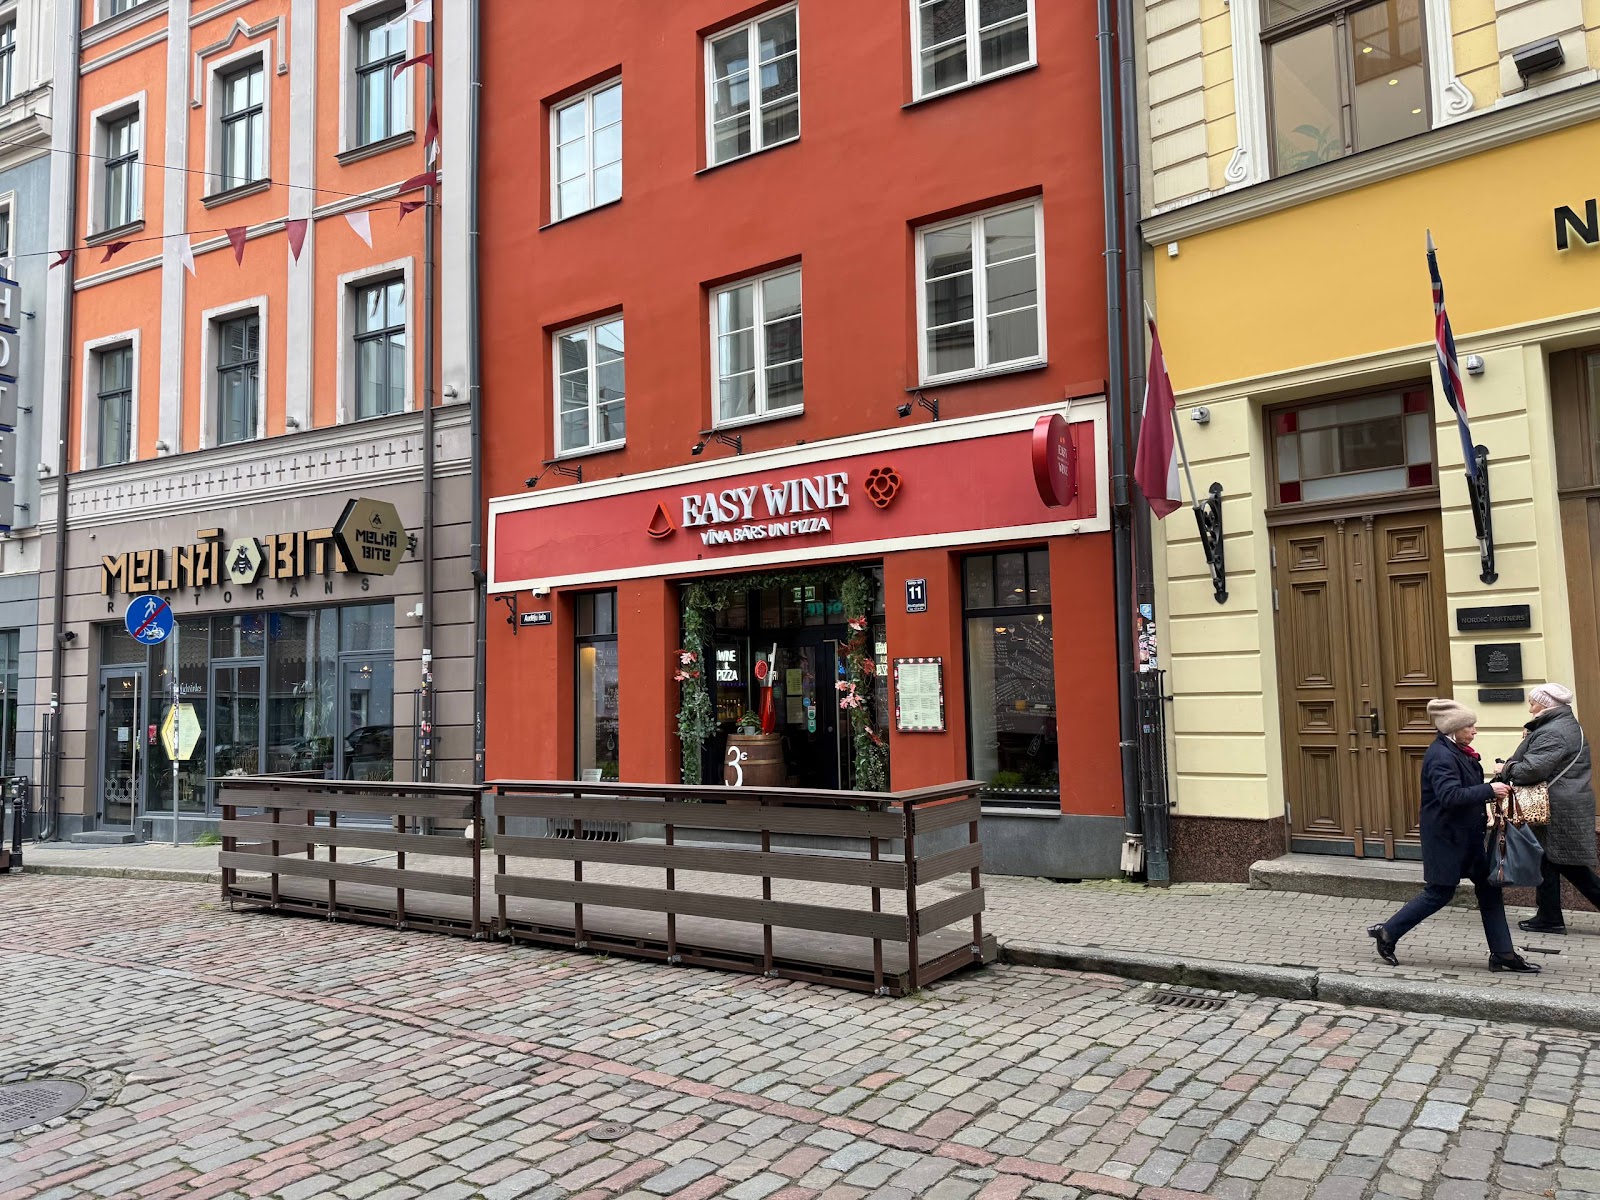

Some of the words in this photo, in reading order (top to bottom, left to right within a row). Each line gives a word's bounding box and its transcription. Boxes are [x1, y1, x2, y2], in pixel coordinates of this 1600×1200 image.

[1554, 198, 1599, 250] N
[681, 485, 758, 528] EASY
[762, 472, 849, 517] WINE
[700, 528, 734, 546] VĪNA
[734, 524, 768, 542] BĀRS
[768, 521, 789, 537] UN
[790, 517, 832, 535] PIZZA
[107, 577, 370, 612] RSTORĀNS
[908, 586, 922, 600] 11
[1461, 616, 1488, 624] NORDIC
[1489, 614, 1526, 623] PARTNERS
[716, 669, 739, 682] PIZZA
